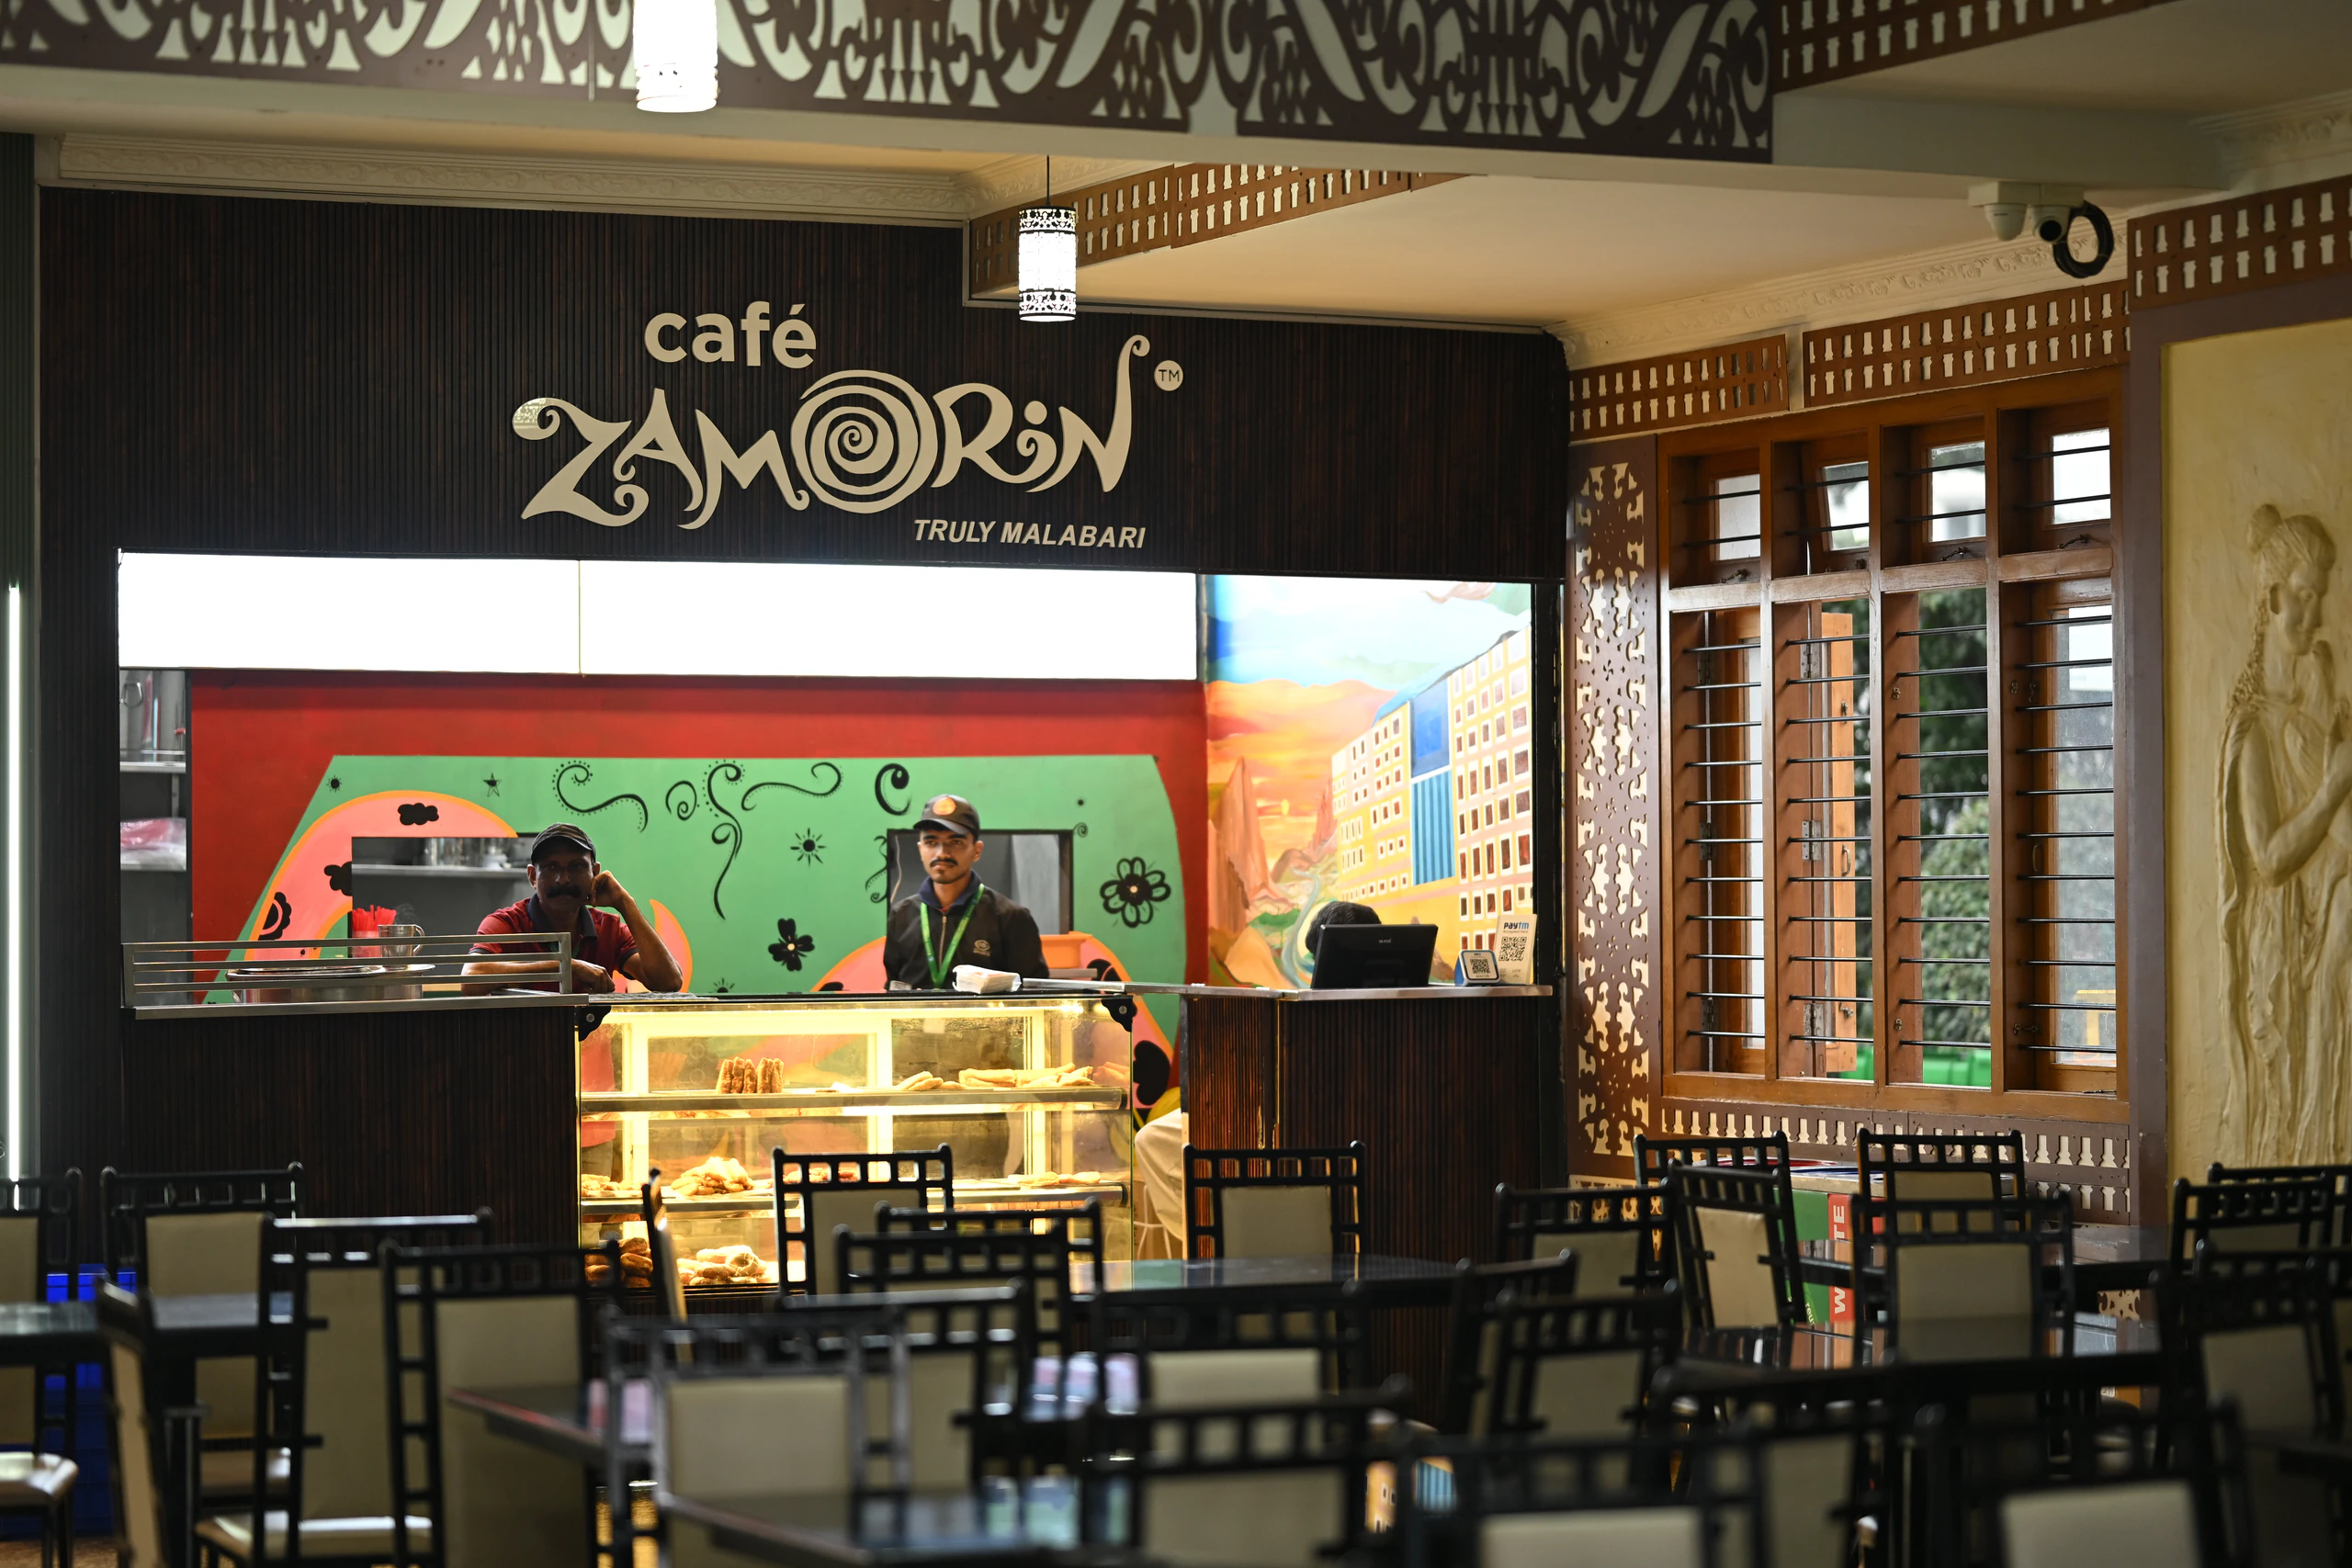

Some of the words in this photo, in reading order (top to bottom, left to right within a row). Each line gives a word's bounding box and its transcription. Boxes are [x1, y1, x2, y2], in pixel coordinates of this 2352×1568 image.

[644, 300, 817, 369] café
[914, 519, 996, 544] TRULY
[1000, 521, 1147, 548] MALABARI
